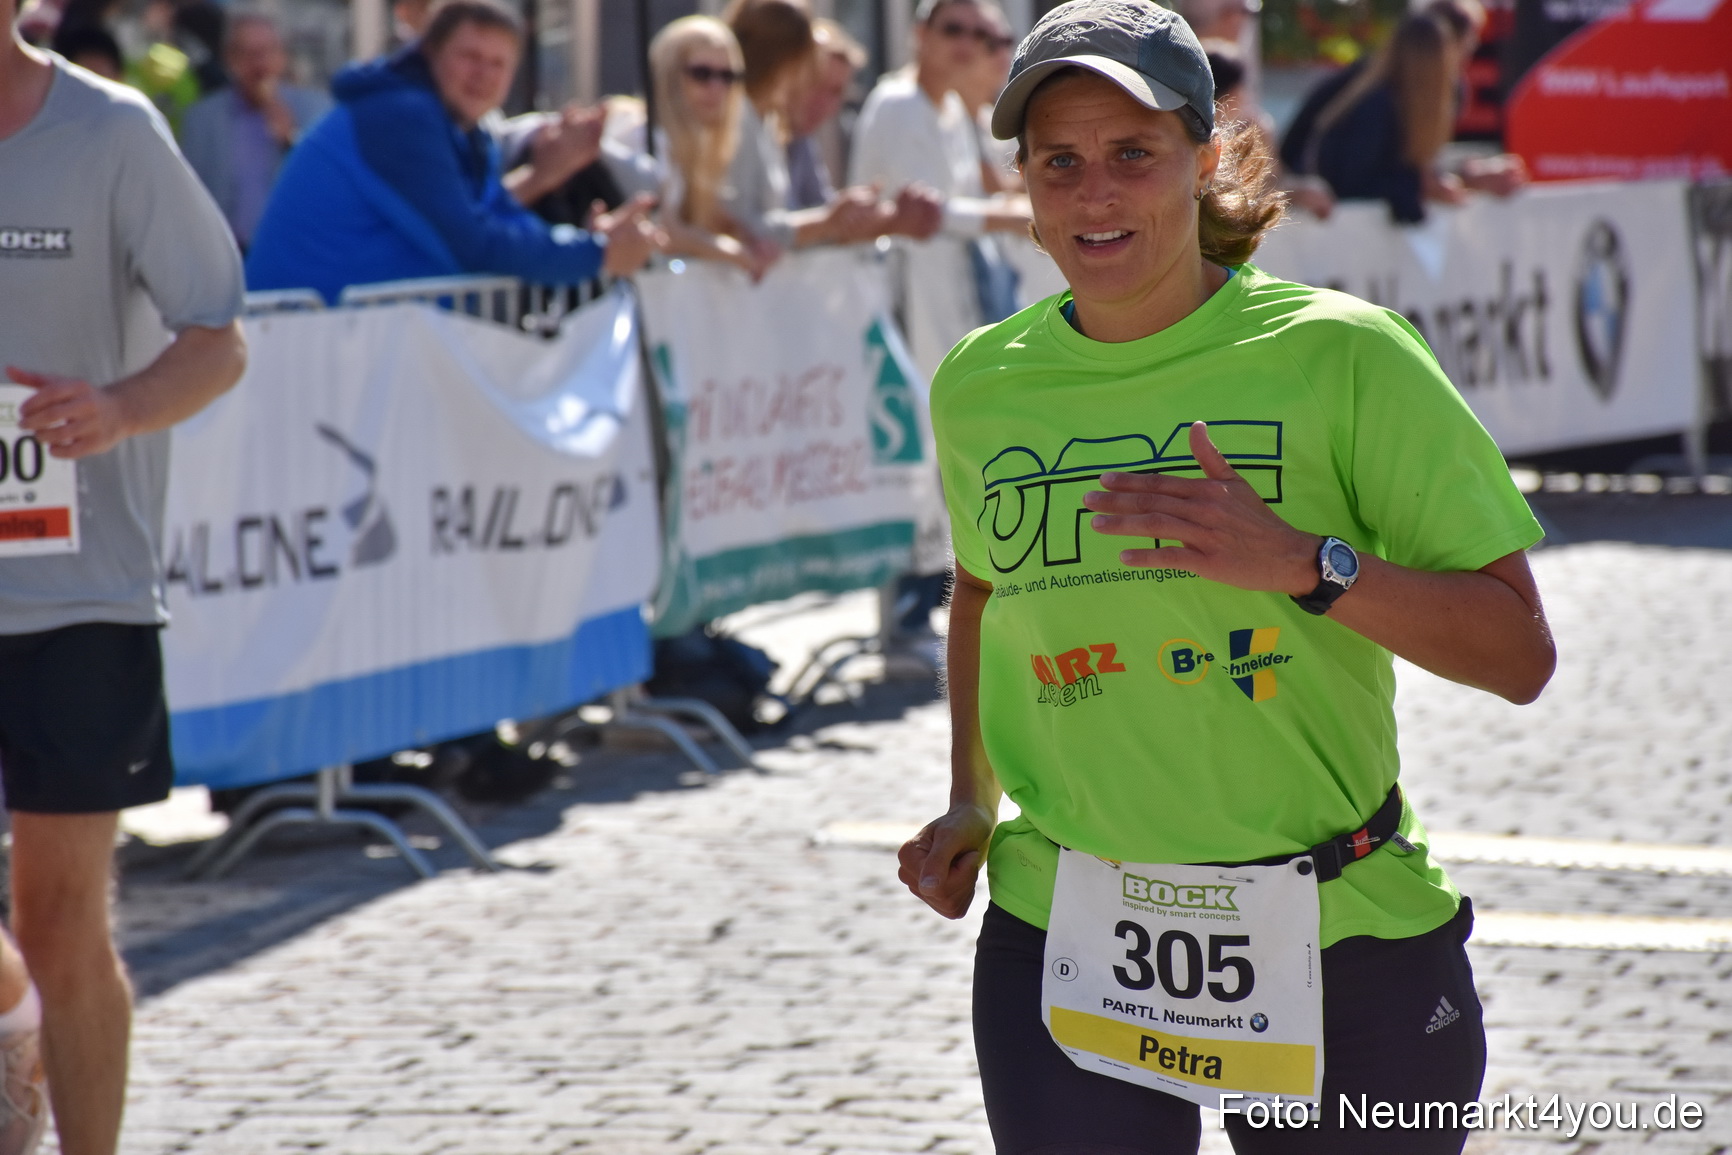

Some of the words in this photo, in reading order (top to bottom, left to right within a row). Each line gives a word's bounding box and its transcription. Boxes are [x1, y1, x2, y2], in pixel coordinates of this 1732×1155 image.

[0, 230, 70, 251] OCK
[166, 508, 340, 597] AIL.ONE
[1026, 576, 1047, 592] und
[1050, 568, 1201, 589] Automatisierungstec
[1123, 872, 1240, 912] BOCK
[1123, 898, 1155, 913] inspired
[1157, 906, 1167, 917] by
[1169, 909, 1197, 919] smart
[1199, 911, 1241, 922] concepts
[1112, 919, 1256, 1003] 305
[1102, 997, 1159, 1021] PARTL
[1163, 1008, 1244, 1029] Neumarkt
[1425, 1009, 1460, 1034] adidas
[1139, 1034, 1223, 1081] Petra
